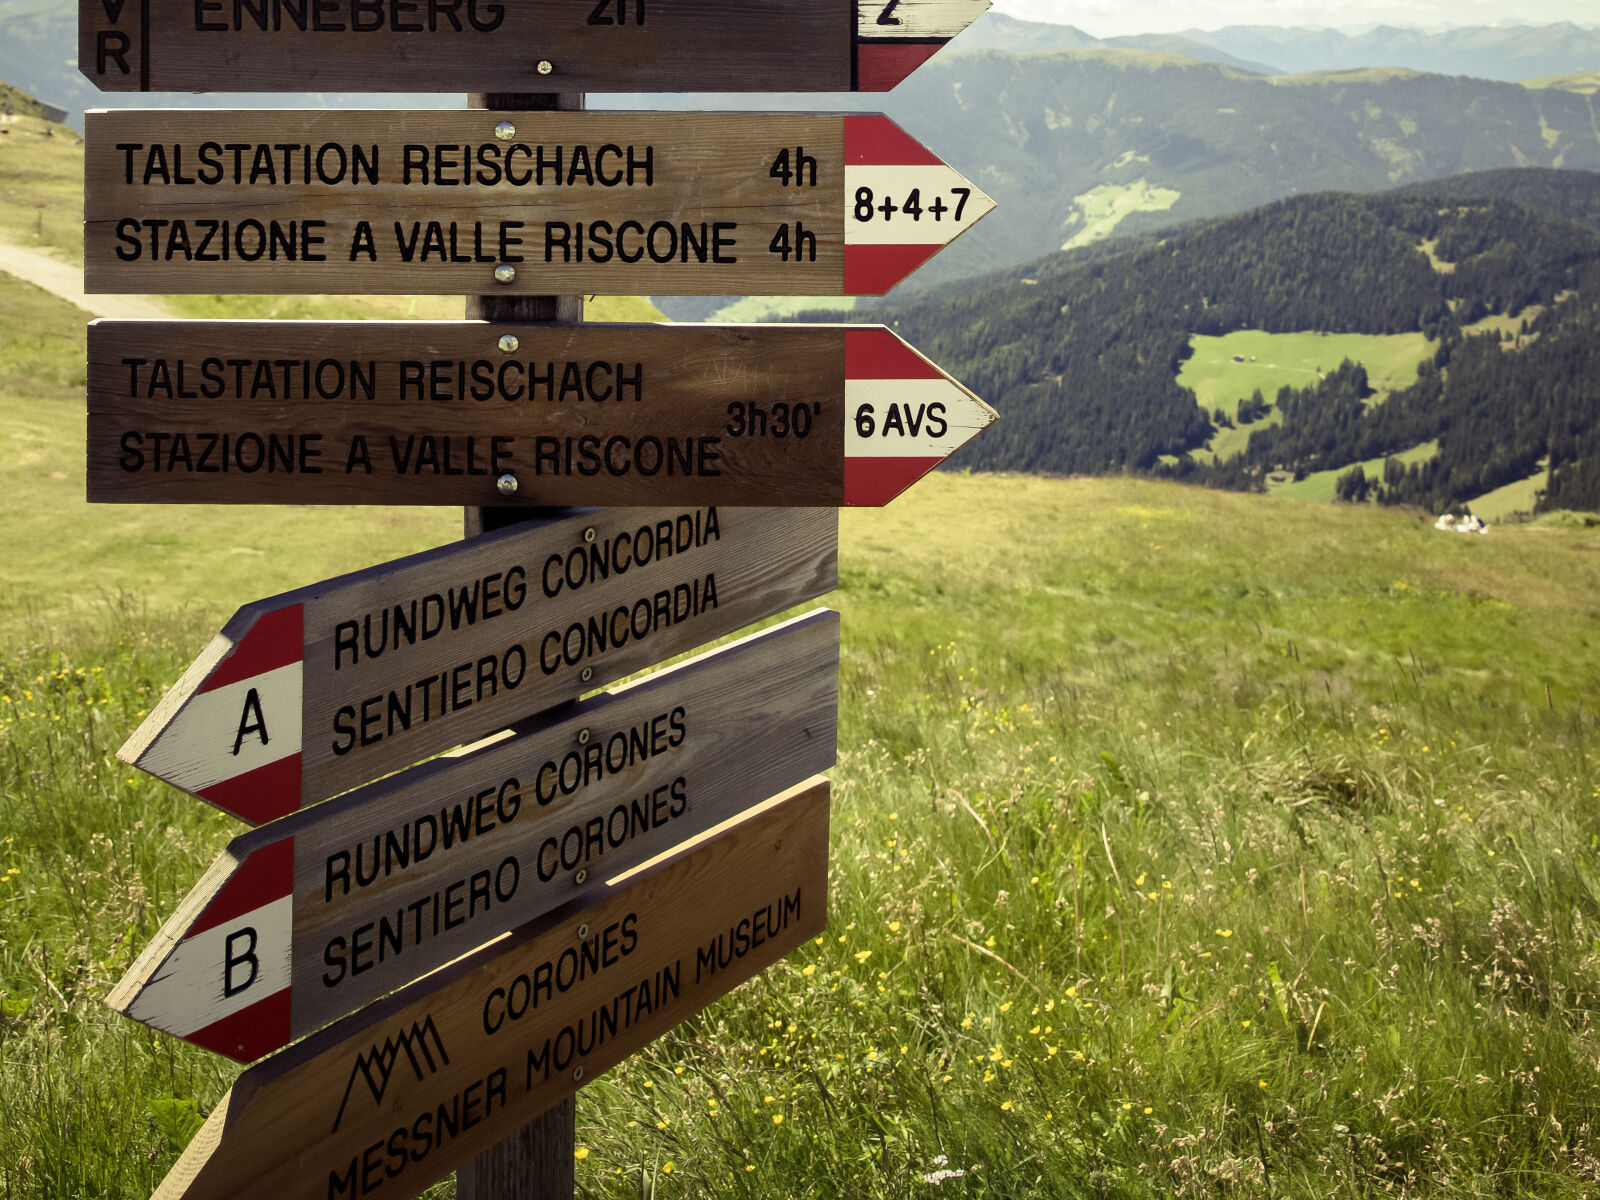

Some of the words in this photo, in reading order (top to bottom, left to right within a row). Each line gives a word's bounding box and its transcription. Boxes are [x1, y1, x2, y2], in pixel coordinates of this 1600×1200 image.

[116, 142, 379, 186] TALSTATION
[402, 143, 654, 187] REISCHACH
[769, 147, 817, 187] 4h
[854, 187, 971, 223] 8+4+7
[115, 217, 326, 262] STAZIONE
[349, 221, 377, 262] A
[394, 221, 524, 263] VALLE
[545, 220, 737, 264] RISCONE
[769, 222, 817, 262] 4h
[121, 357, 376, 400] TALSTATION
[400, 360, 642, 402] REISCHACH
[119, 431, 323, 474] STAZIONE
[345, 435, 373, 475] A
[388, 435, 514, 476] VALLE
[535, 435, 722, 478] RISCONE
[727, 401, 820, 438] 3h30'
[855, 402, 875, 438] 6
[882, 402, 948, 438] AVS
[334, 565, 526, 670] RUNDWEG
[542, 506, 720, 598] CONCORDIA
[332, 644, 526, 757] SENTIERO
[540, 573, 718, 675] CONCORDIA
[232, 687, 270, 757] A
[325, 777, 521, 903] RUNDWEG
[535, 706, 687, 808] CORONES
[323, 859, 520, 988] SENTIERO
[536, 776, 688, 882] CORONES
[224, 927, 258, 998] B
[483, 913, 637, 1035] CORONES
[328, 1067, 506, 1200] MESSNER
[526, 960, 680, 1091] MOUNTAIN
[696, 888, 800, 984] MUSEUM
